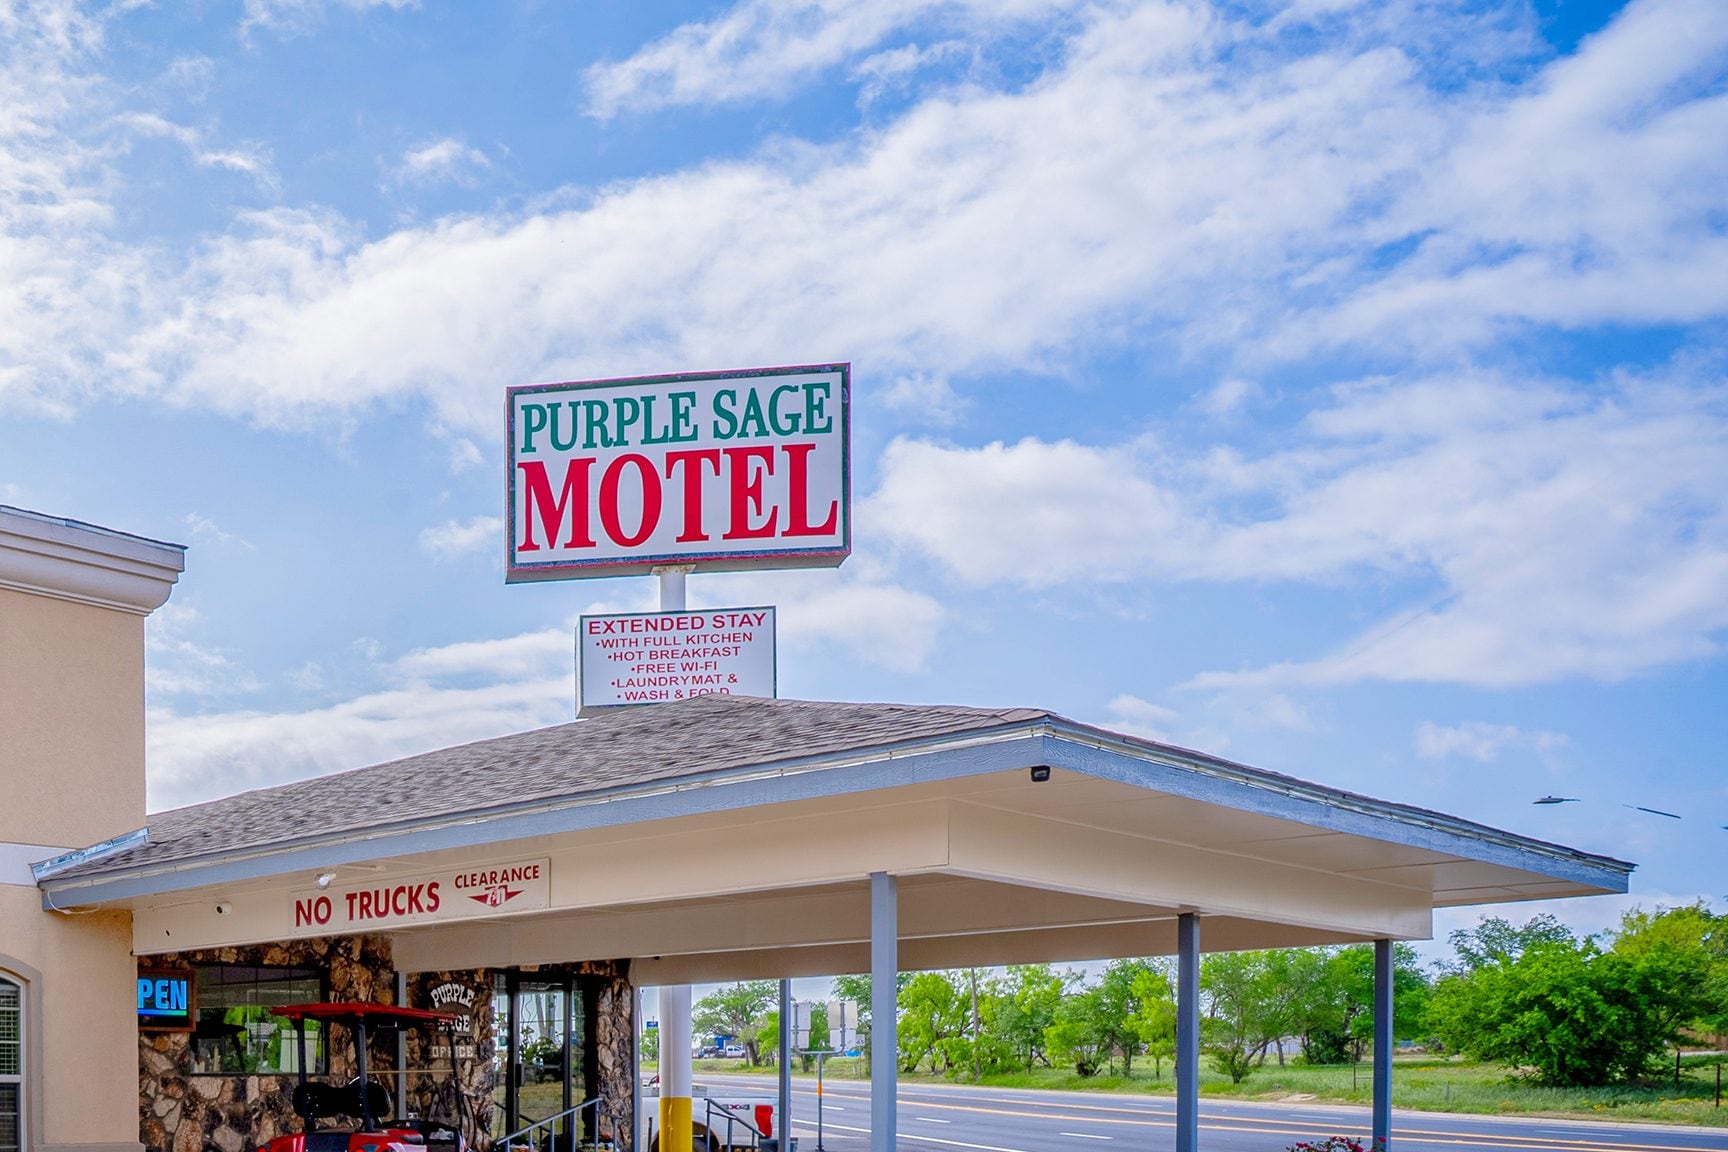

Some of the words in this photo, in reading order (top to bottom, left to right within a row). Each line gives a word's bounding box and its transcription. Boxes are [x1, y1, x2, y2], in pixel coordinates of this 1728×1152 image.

[520, 390, 699, 453] PURPLE
[712, 382, 833, 440] SAGE
[516, 443, 838, 552] MOTEL
[588, 616, 705, 635] EXTENDED
[712, 612, 767, 629] STAY
[601, 637, 639, 649] WITH
[643, 636, 682, 647] FULL
[686, 631, 753, 645] KITCHEN
[613, 650, 645, 662] HOT
[649, 646, 741, 660] BREAKFAST
[636, 662, 676, 674] FREE
[680, 661, 717, 672] WI-FI
[727, 673, 738, 684] &
[624, 689, 669, 701] WASH
[674, 688, 684, 699] &
[454, 865, 540, 889] CLEARANCE
[295, 895, 332, 927] NO
[345, 881, 441, 921] TRUCKS
[137, 978, 187, 1010] PEN
[430, 983, 475, 1009] PURPLE
[438, 1014, 471, 1033] GE
